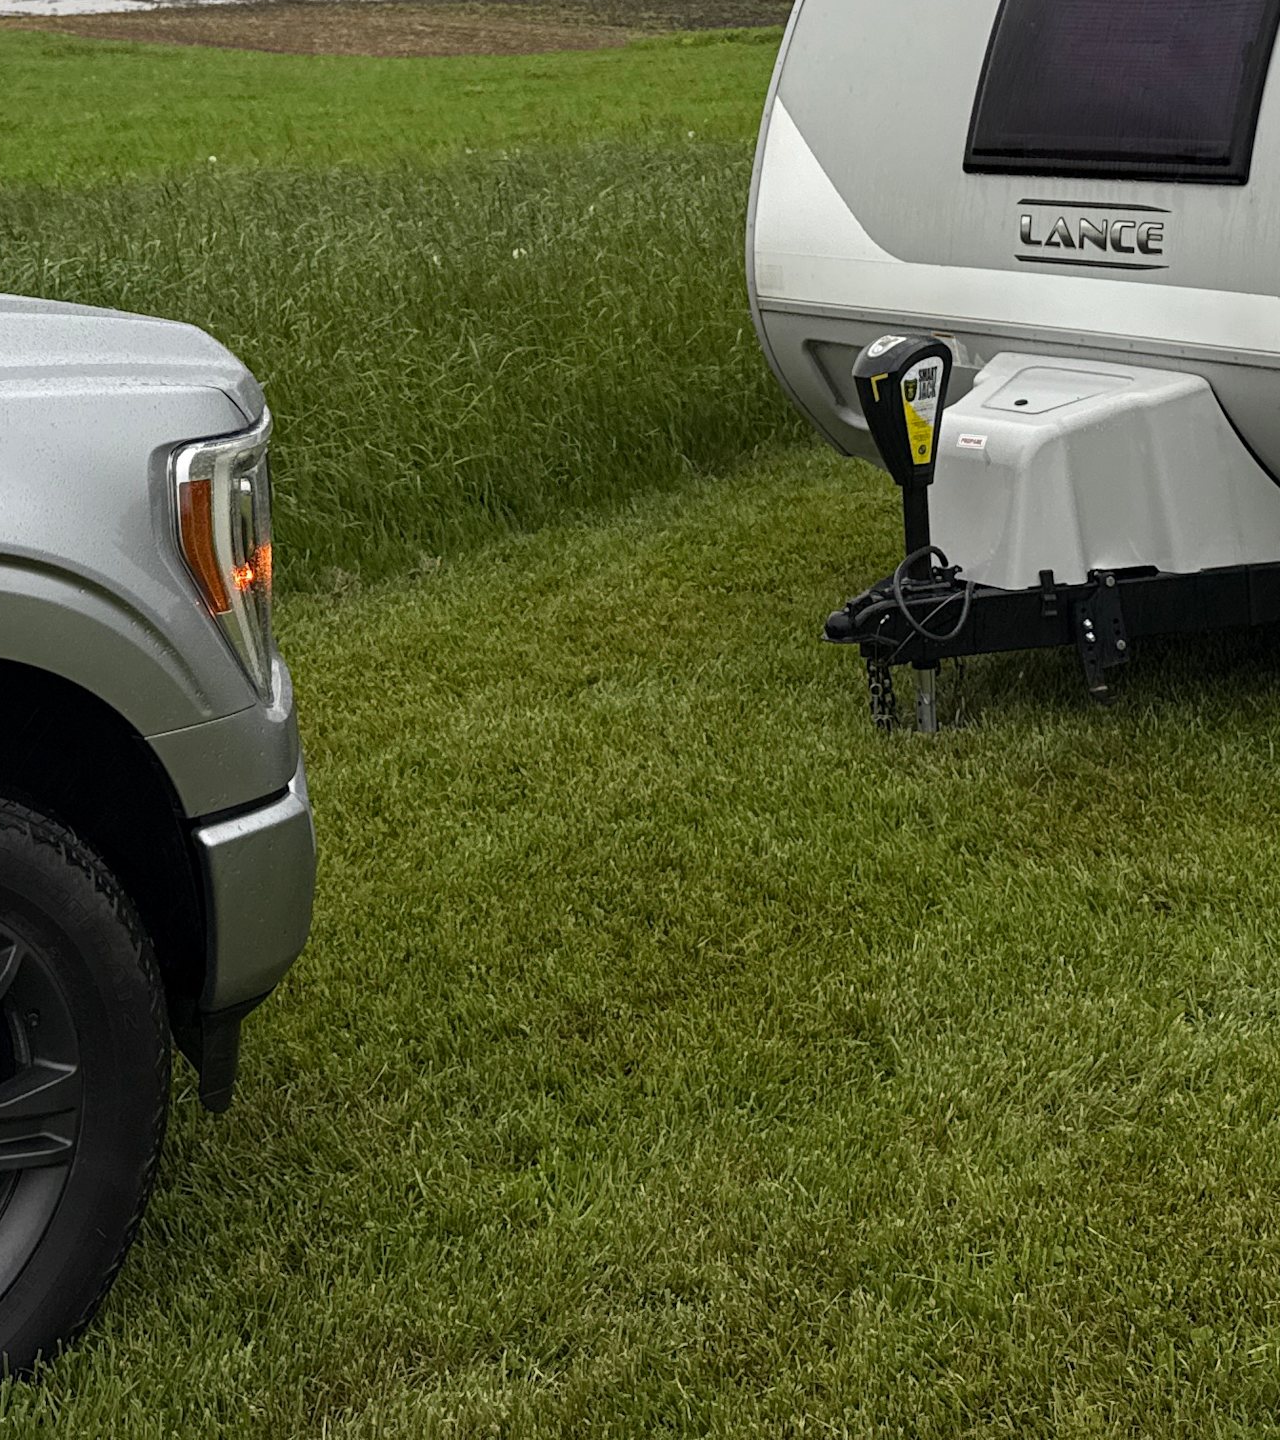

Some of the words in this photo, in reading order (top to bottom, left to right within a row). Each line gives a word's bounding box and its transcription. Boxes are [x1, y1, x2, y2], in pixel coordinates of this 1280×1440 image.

[1020, 214, 1164, 254] LANCE
[919, 366, 937, 382] SMART
[918, 381, 936, 400] JACK
